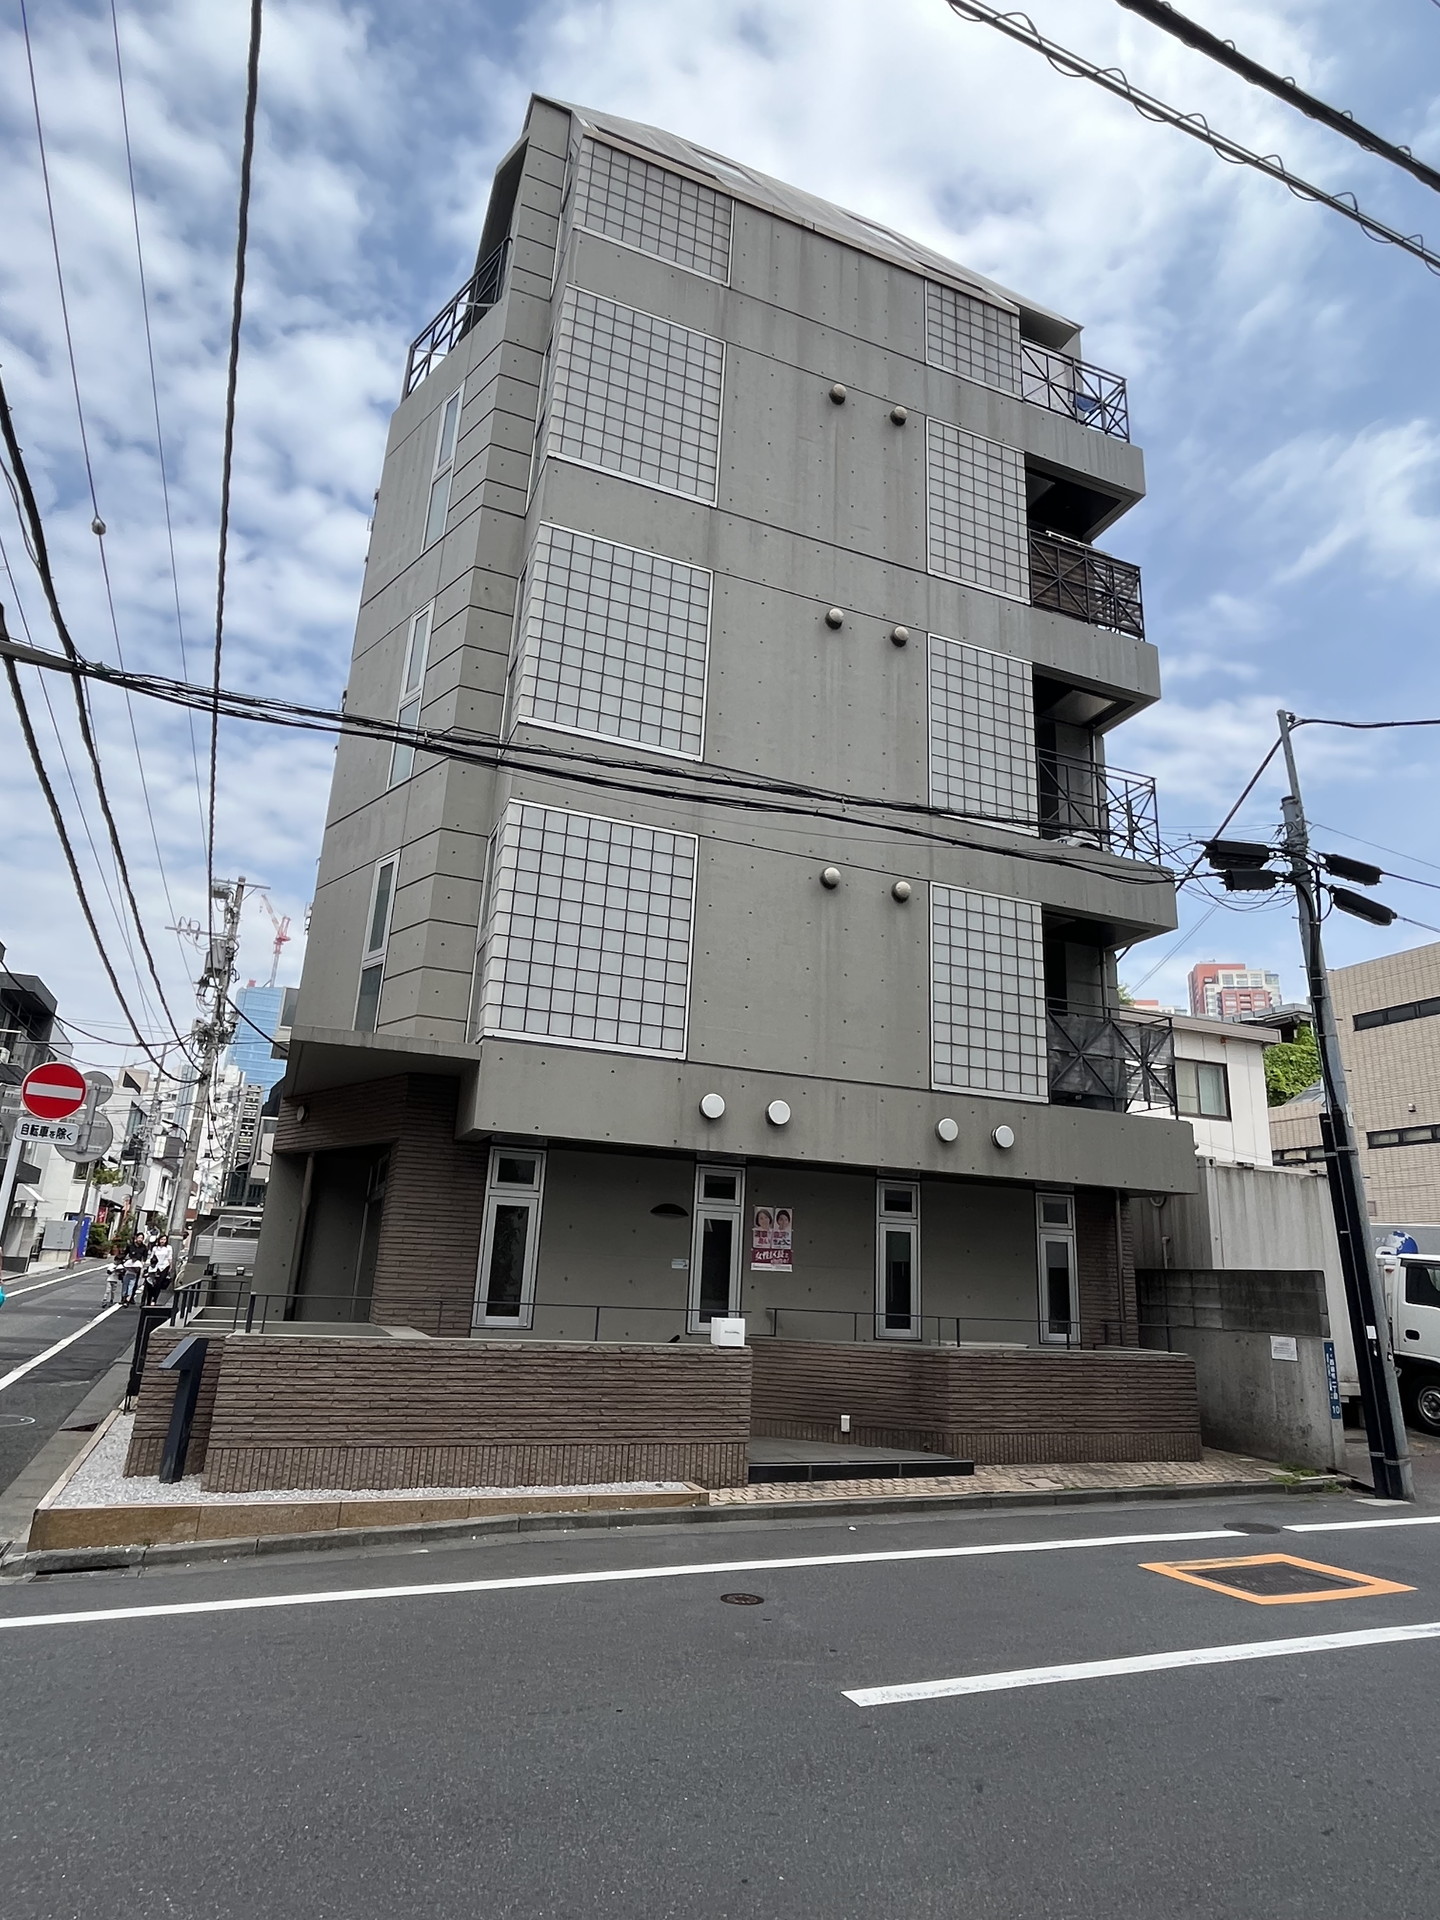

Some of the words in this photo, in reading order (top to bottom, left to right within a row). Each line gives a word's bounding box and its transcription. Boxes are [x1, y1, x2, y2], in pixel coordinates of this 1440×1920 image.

[20, 1123, 73, 1141] 自転車を除く
